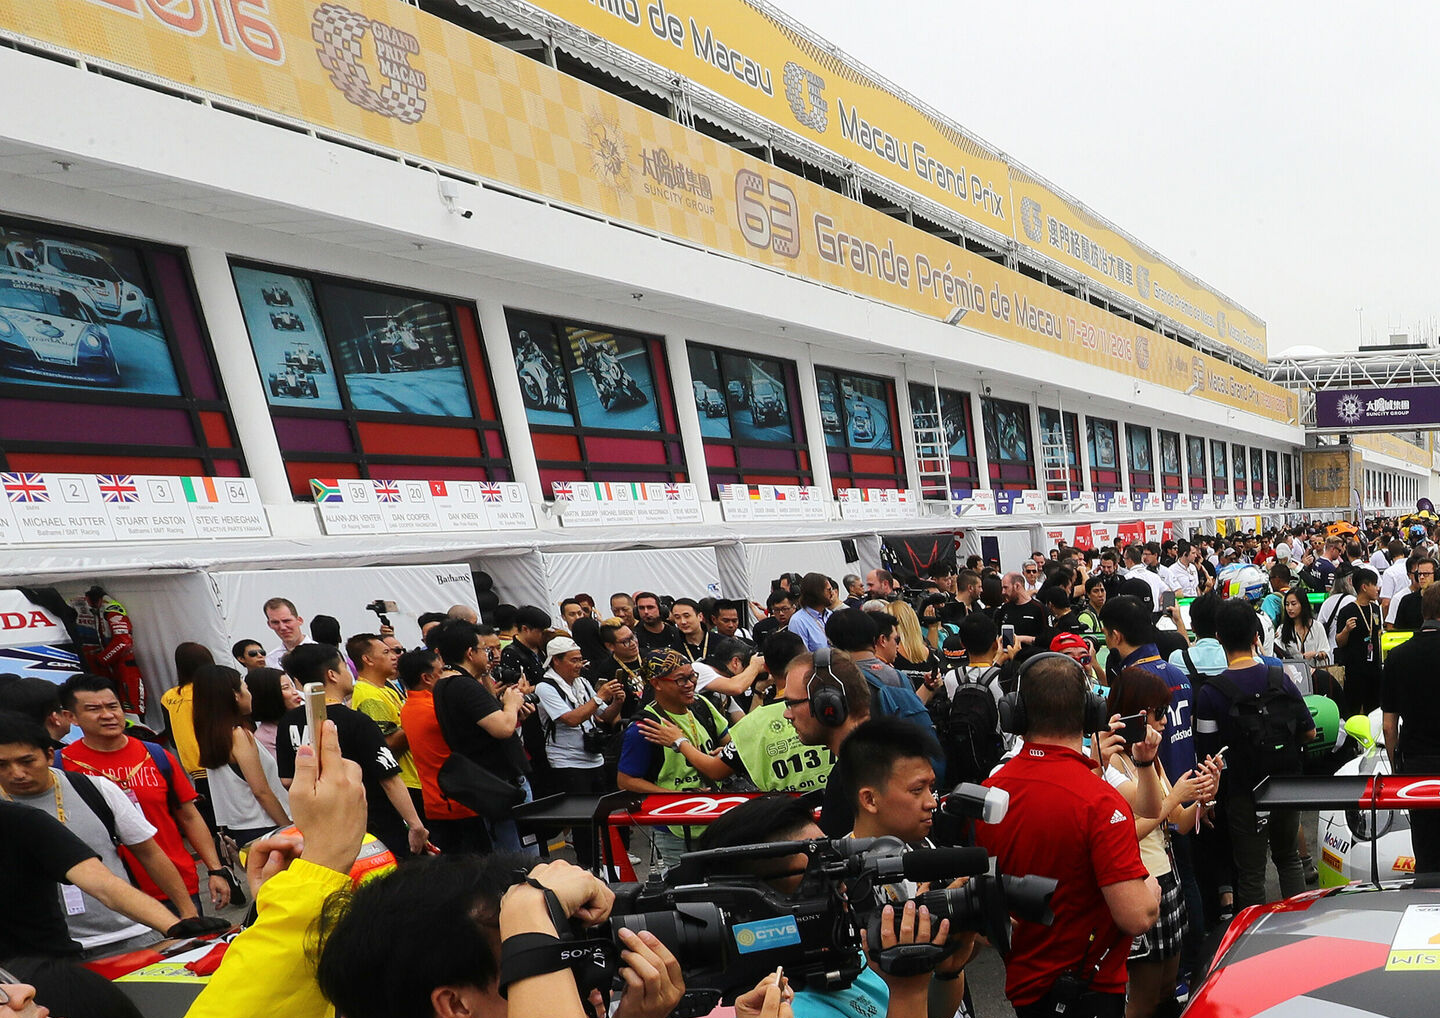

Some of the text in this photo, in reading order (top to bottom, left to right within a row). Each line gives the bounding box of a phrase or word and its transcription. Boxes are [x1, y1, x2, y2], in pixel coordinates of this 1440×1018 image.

[371, 20, 419, 55] GRAND
[376, 39, 410, 68] PRIX
[689, 16, 775, 97] Macau
[379, 57, 426, 92] MACAU
[837, 97, 1005, 220] Macau Grand Prix
[643, 182, 715, 216] SUNCITY GROUP
[735, 168, 800, 259] 63
[813, 211, 1062, 341] Grande Prémio de Macau
[1207, 369, 1229, 394] Macau
[1229, 377, 1249, 401] Grand
[69, 484, 80, 497] 2
[157, 485, 167, 498] 3
[230, 485, 245, 499] 54
[353, 486, 366, 498] 39
[410, 487, 422, 498] 20
[464, 488, 470, 498] 7
[22, 516, 107, 527] MICHAEL RUTTER
[115, 516, 187, 526] STUART EASTON
[195, 515, 261, 525] STEVE HENEGHAN
[359, 513, 382, 522] VENTER
[392, 513, 430, 521] DAN COOPER
[449, 513, 479, 521] DAN KNEEN
[81, 528, 100, 537] Racing
[436, 573, 471, 585] Bathams
[1323, 832, 1350, 854] Mobil 1
[796, 913, 821, 923] SONY
